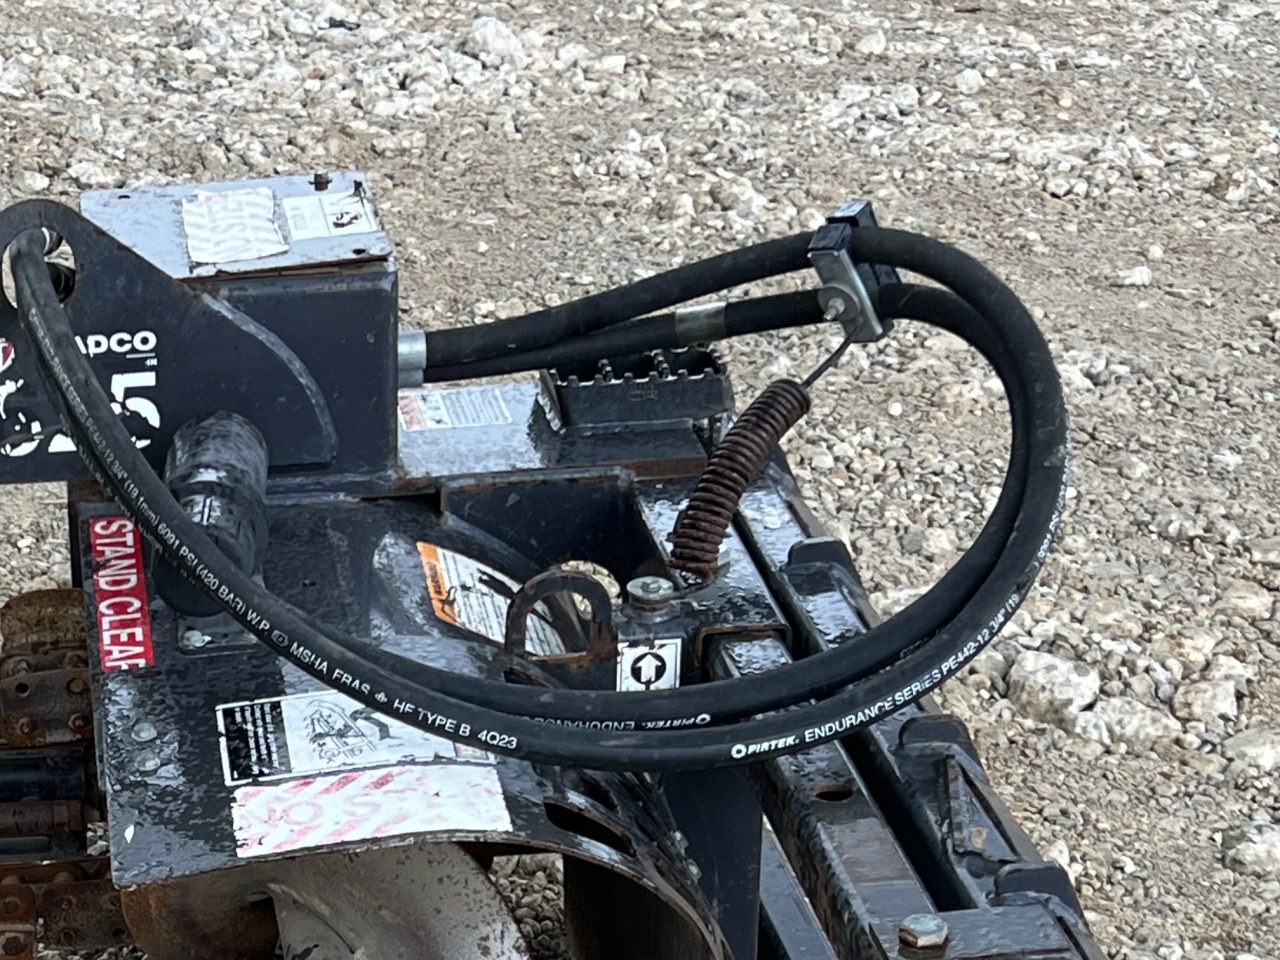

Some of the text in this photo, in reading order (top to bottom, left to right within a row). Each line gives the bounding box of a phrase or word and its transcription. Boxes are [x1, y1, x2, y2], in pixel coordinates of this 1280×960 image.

[94, 519, 138, 592] STAND
[158, 523, 180, 550] 6091
[179, 546, 199, 568] PSI
[196, 564, 219, 591] (420
[218, 585, 246, 615] BAR)
[290, 641, 329, 674] MSHA
[332, 668, 371, 695] FRAS
[418, 707, 458, 733] TYPE
[459, 723, 471, 737] B
[477, 729, 518, 750] 4Q23
[747, 736, 795, 755] PIRTEK
[804, 698, 896, 743] ENDURANCE
[895, 669, 942, 706] SERIES
[941, 628, 990, 676] PE442-12
